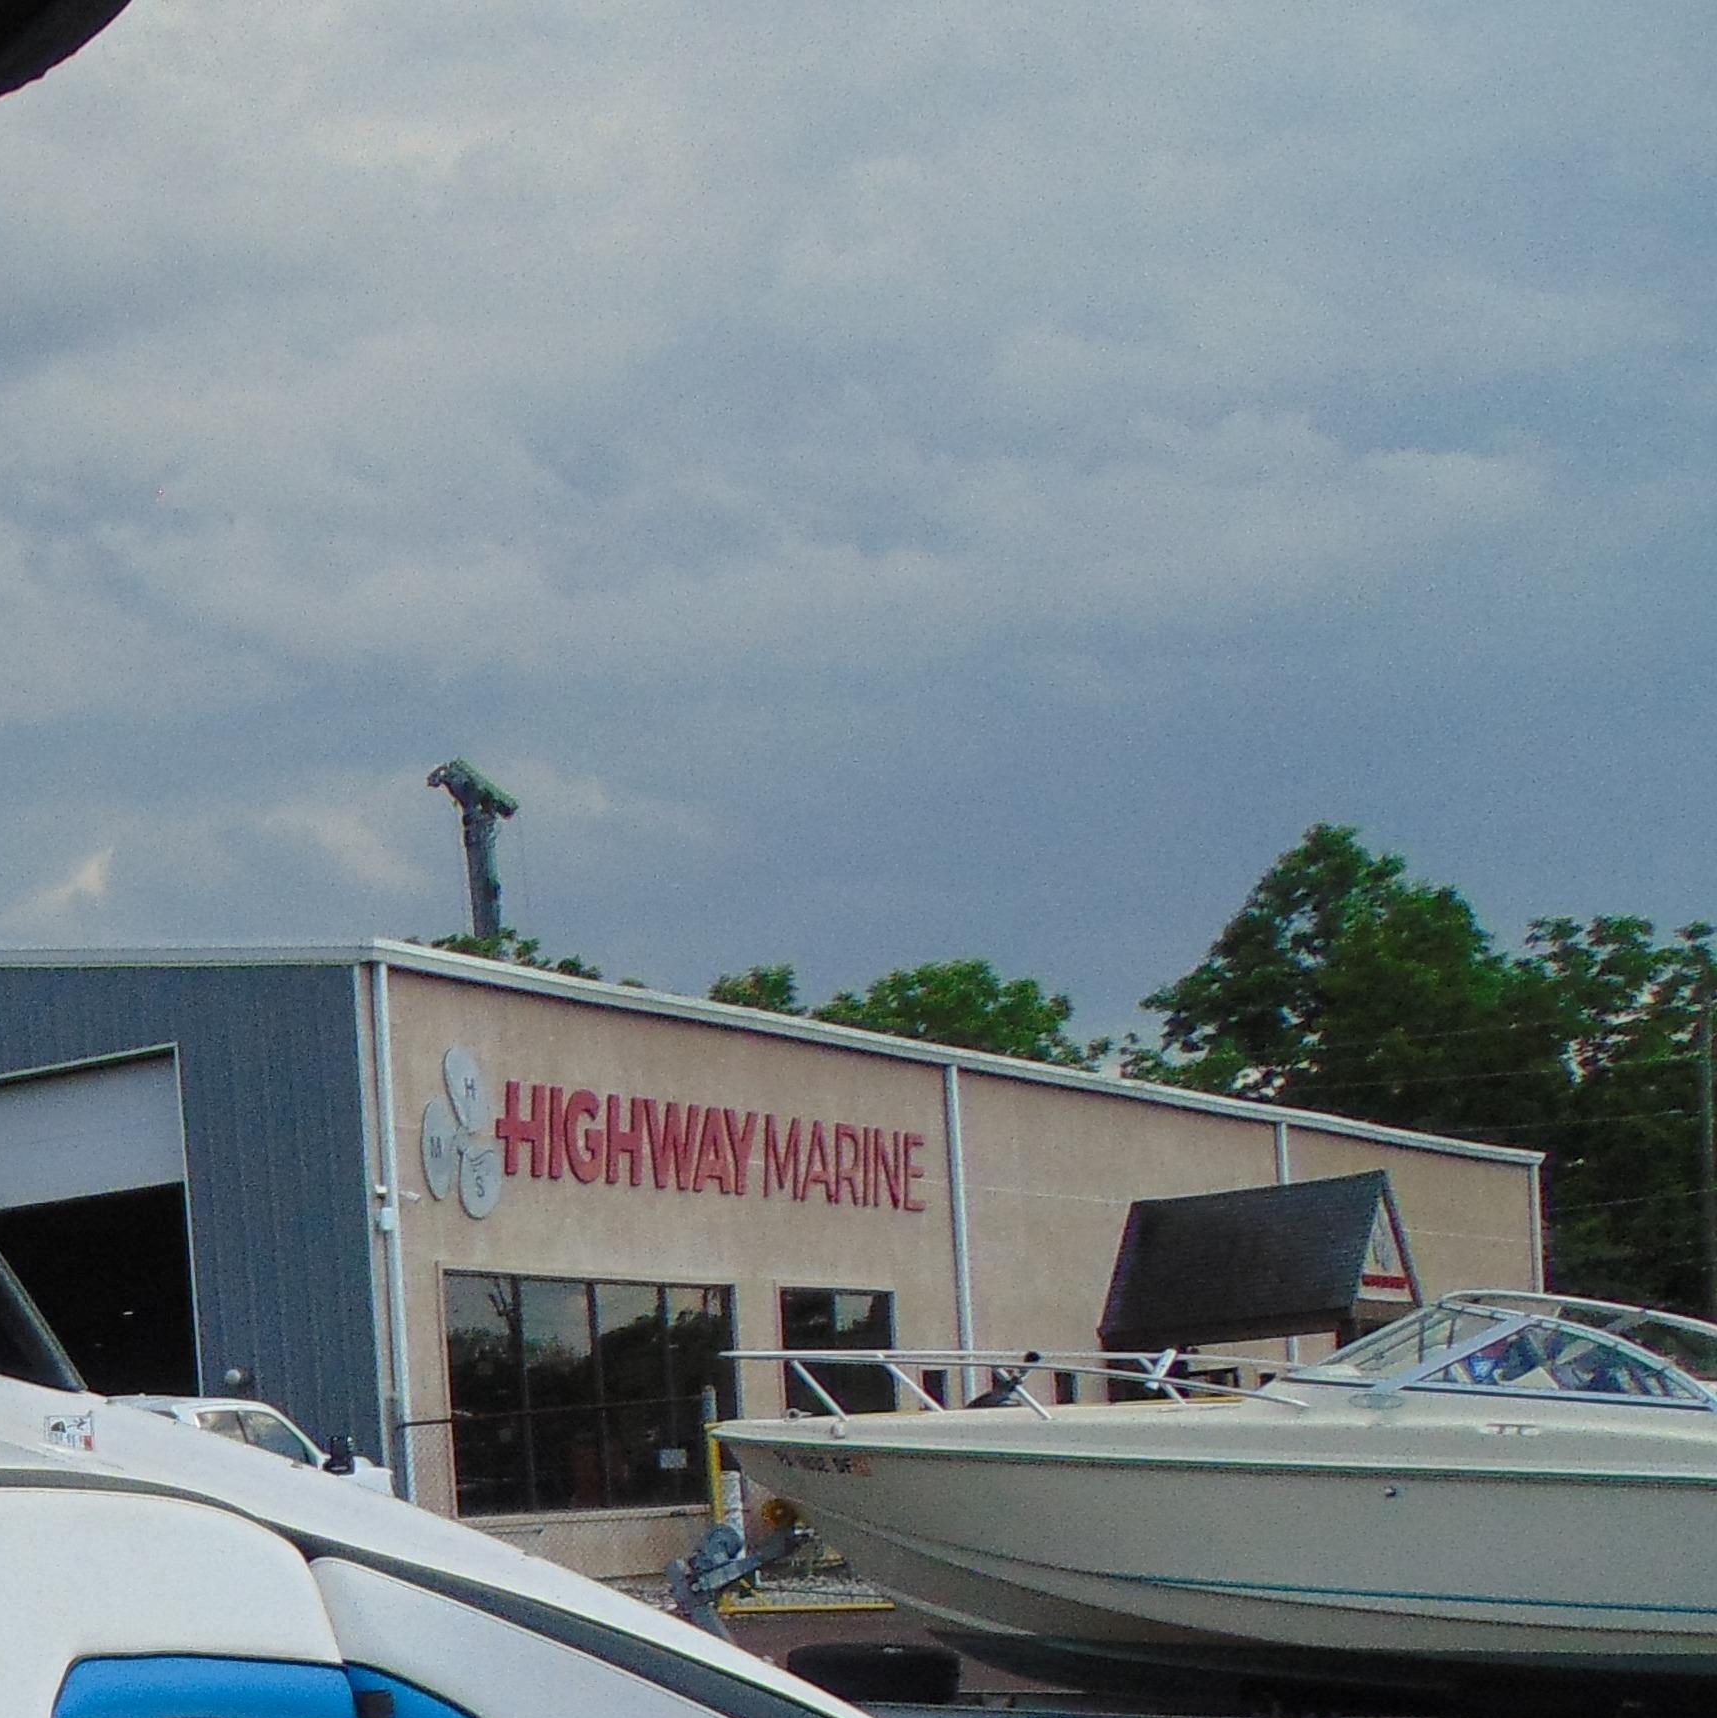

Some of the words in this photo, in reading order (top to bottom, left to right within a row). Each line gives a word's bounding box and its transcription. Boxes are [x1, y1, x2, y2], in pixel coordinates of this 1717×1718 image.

[464, 1077, 476, 1101] H
[495, 1080, 758, 1196] HIGHWAY
[764, 1112, 926, 1212] MARINE
[475, 1175, 487, 1198] S
